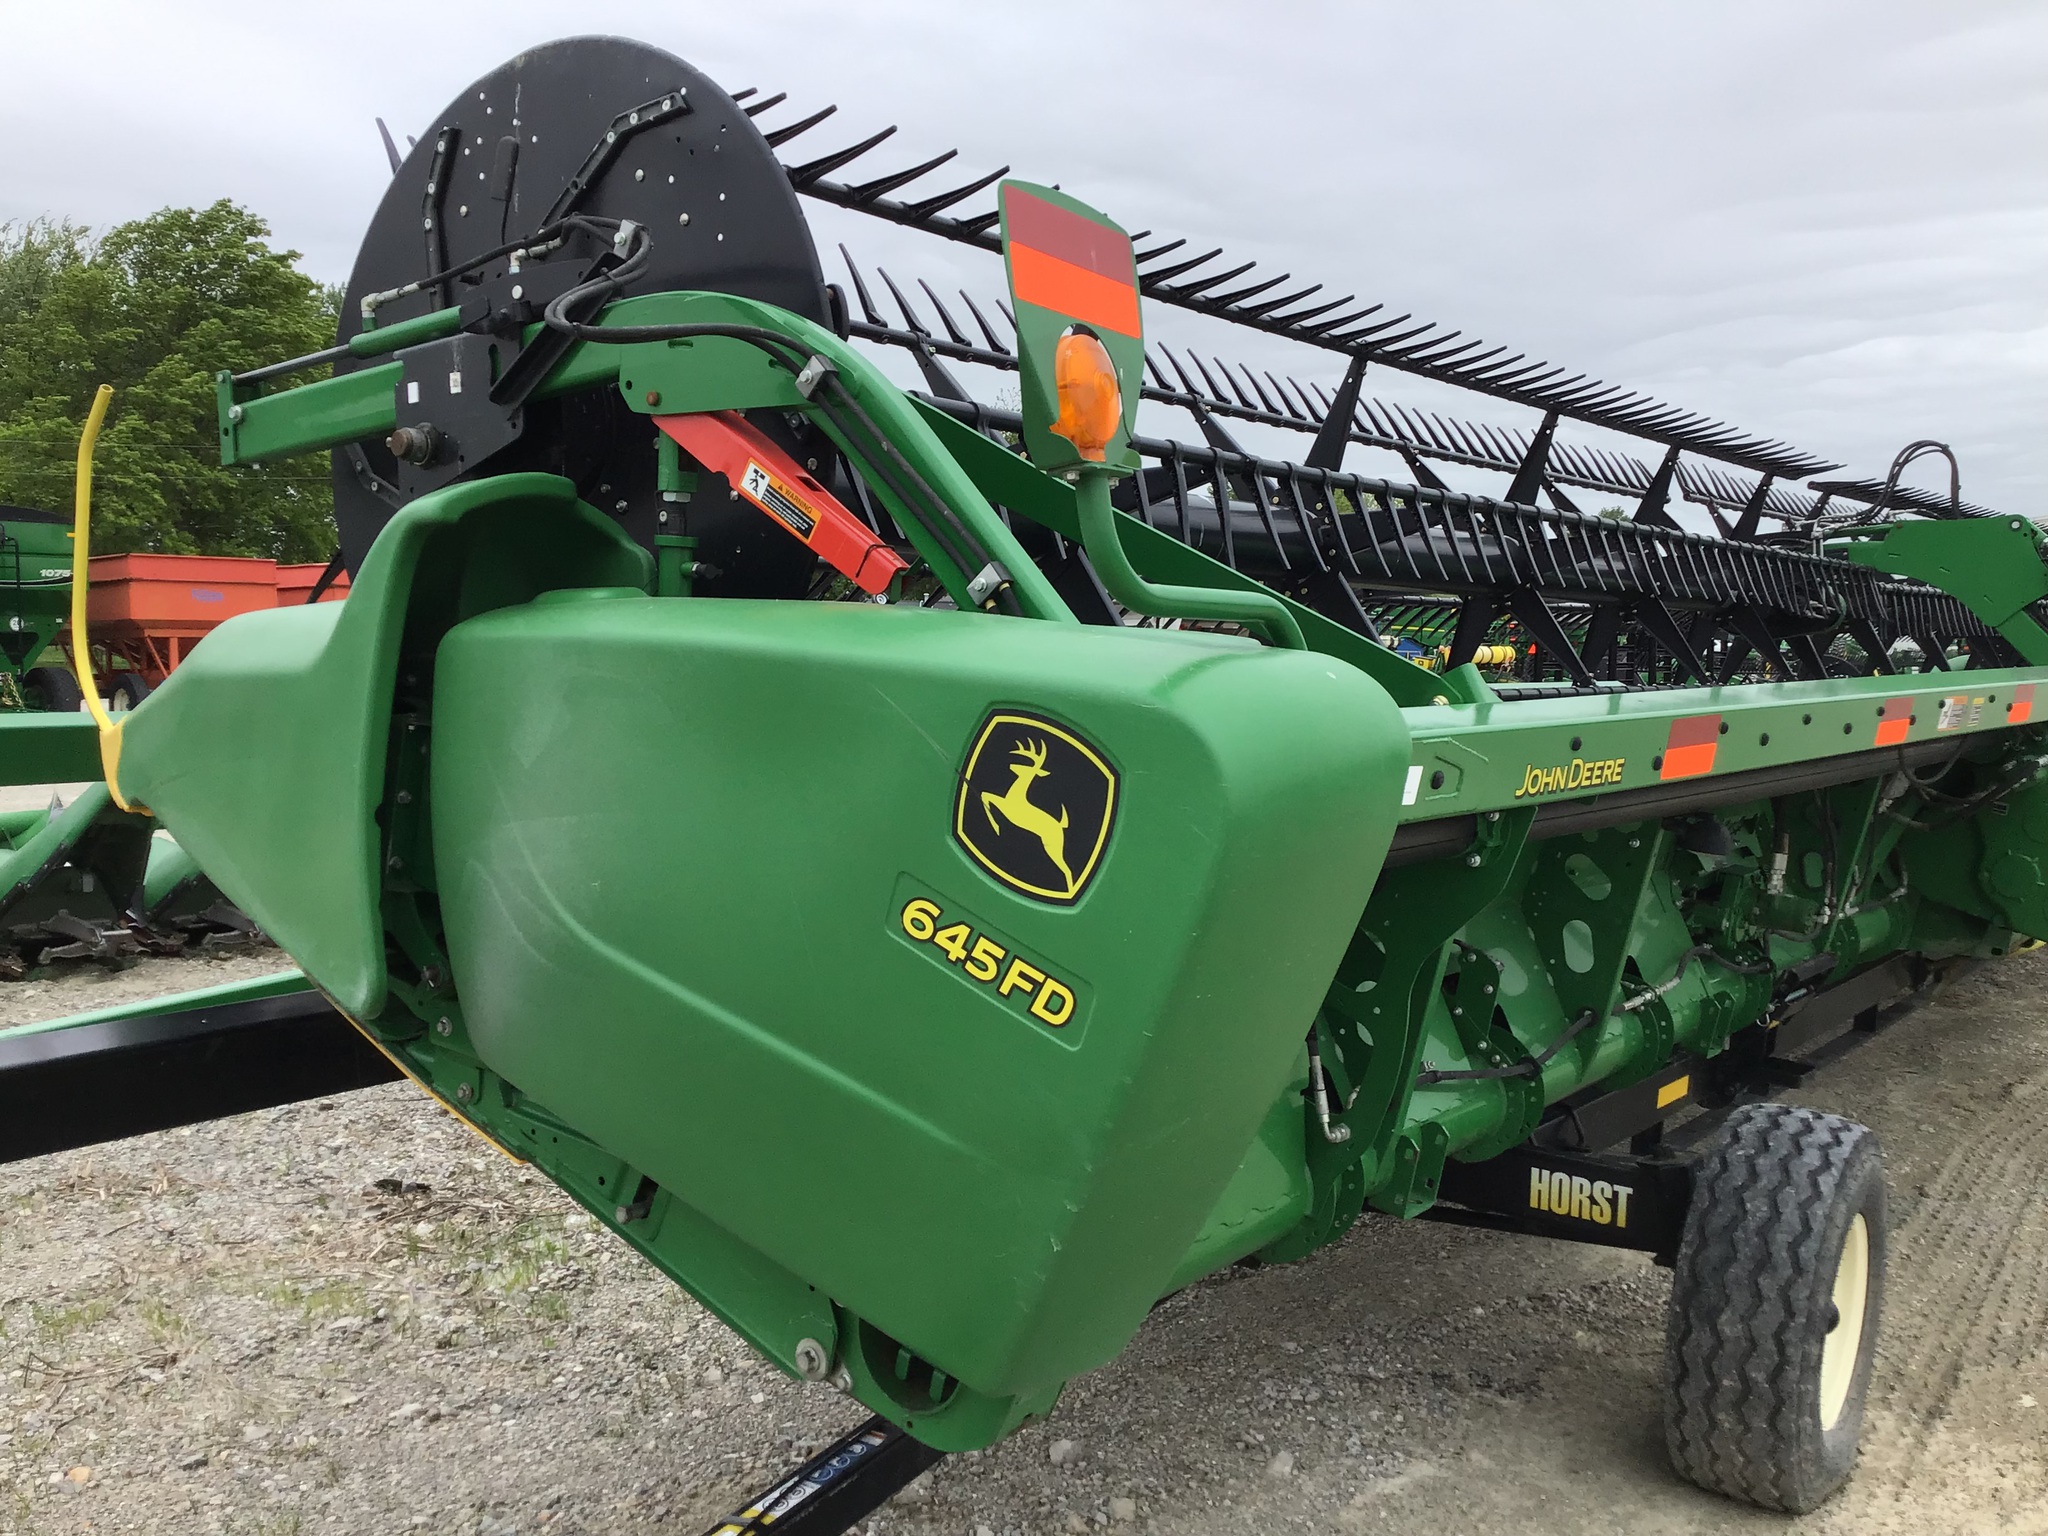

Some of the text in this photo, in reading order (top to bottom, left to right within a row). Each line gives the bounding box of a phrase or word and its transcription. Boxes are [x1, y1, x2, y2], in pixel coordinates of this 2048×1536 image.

[785, 488, 813, 514] WARNING
[39, 569, 72, 578] 1075
[1515, 758, 1626, 798] JOHN DEERE
[901, 897, 1077, 1028] 645FD
[1529, 1166, 1634, 1228] HORST
